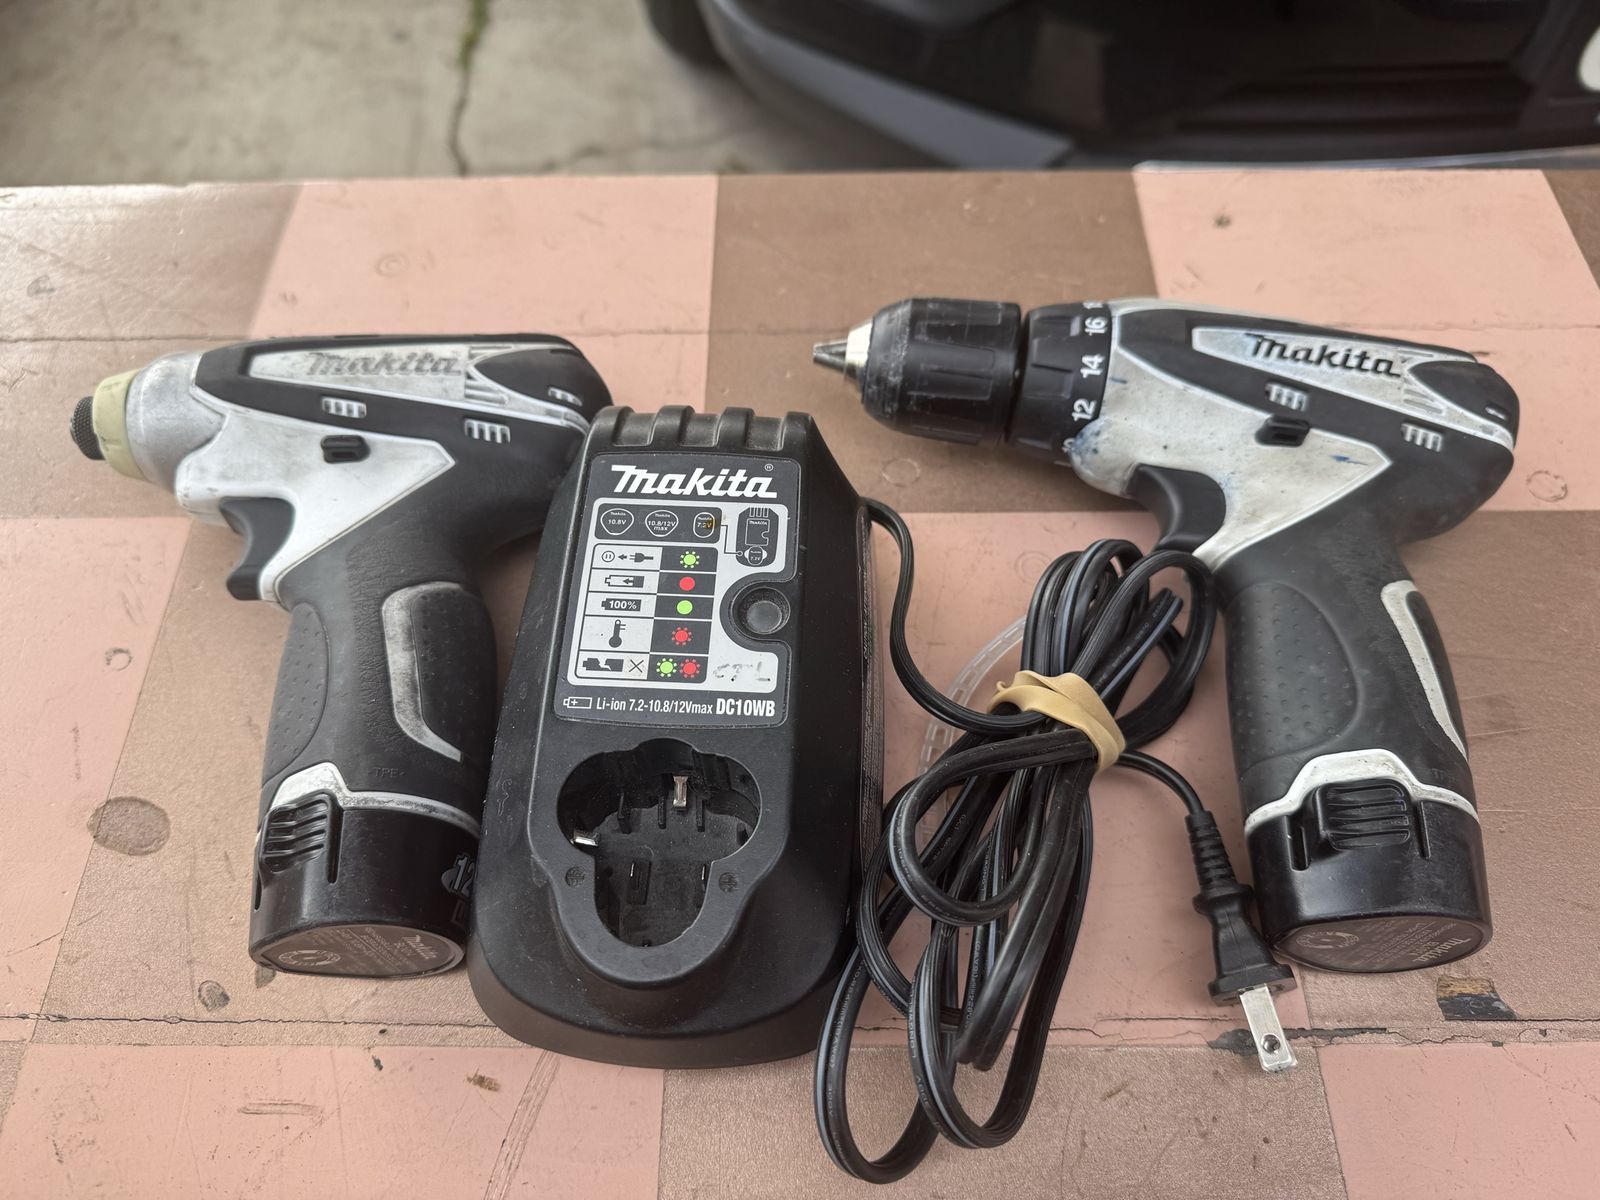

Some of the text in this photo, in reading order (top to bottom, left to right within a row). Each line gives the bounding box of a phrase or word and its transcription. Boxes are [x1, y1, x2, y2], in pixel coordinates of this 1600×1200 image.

[1084, 315, 1108, 337] 16
[1080, 353, 1105, 379] 14
[1071, 398, 1097, 422] 12
[608, 600, 637, 610] 100%
[596, 697, 776, 717] Li-ion 7.2-10.8/12Vmax DC10WB
